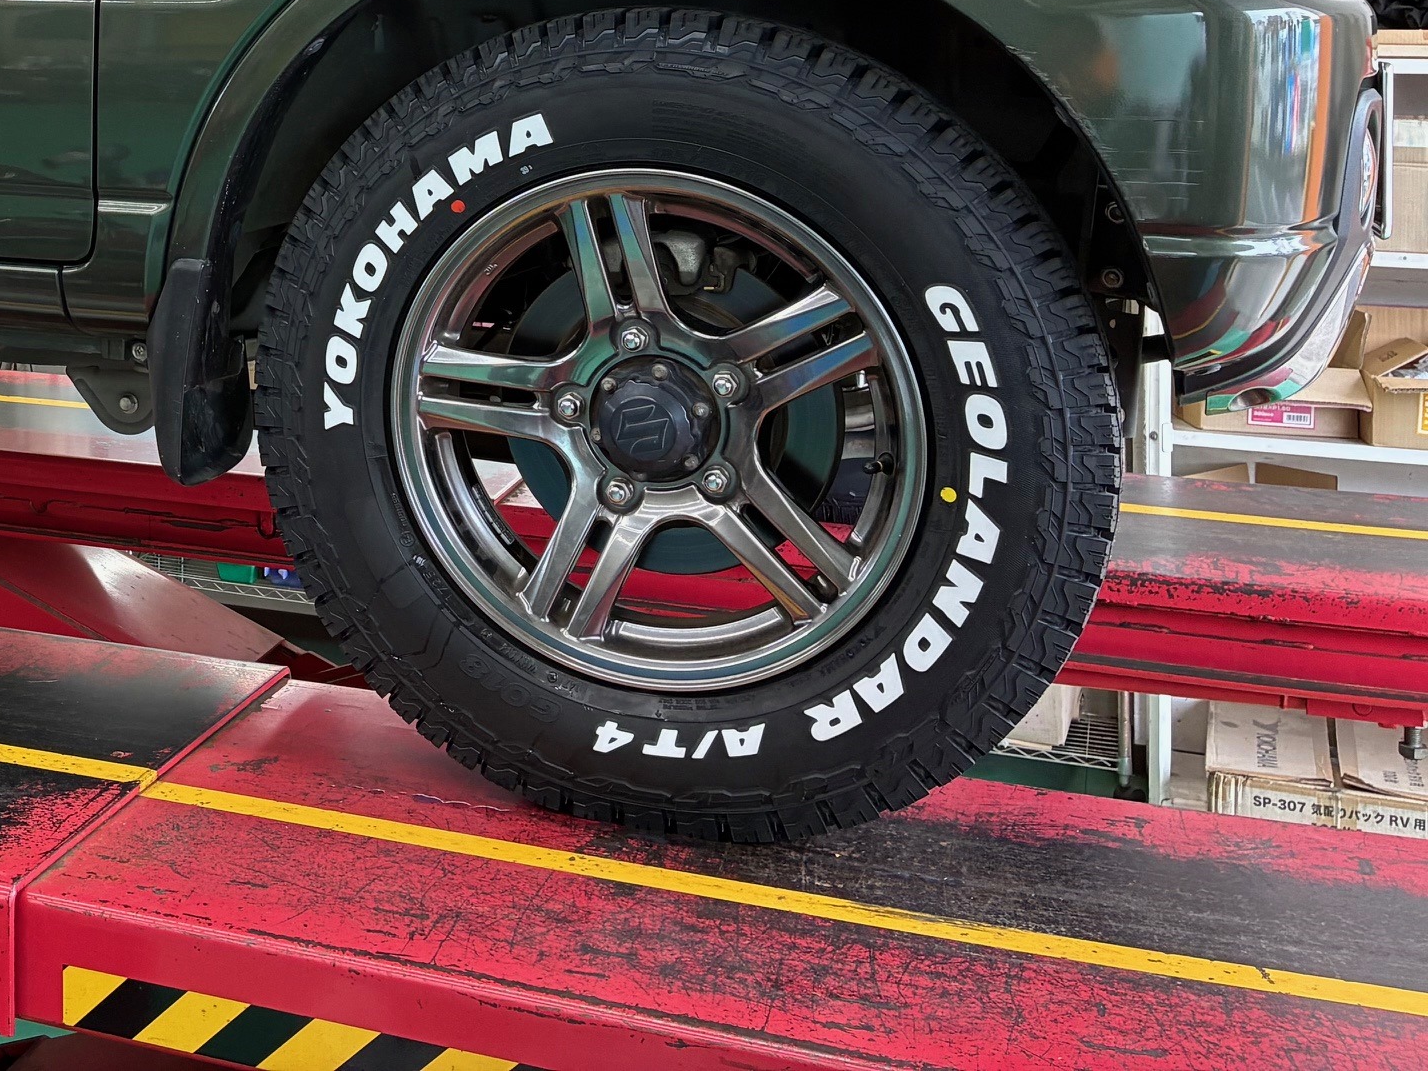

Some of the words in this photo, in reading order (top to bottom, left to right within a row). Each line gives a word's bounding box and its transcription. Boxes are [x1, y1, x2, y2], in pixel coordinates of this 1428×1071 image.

[324, 113, 553, 429] YOKOHAMA
[804, 286, 1008, 741] GEOLANDAR
[1253, 795, 1307, 813] SP-307
[1389, 815, 1410, 829] RV
[1414, 818, 1427, 832] 用
